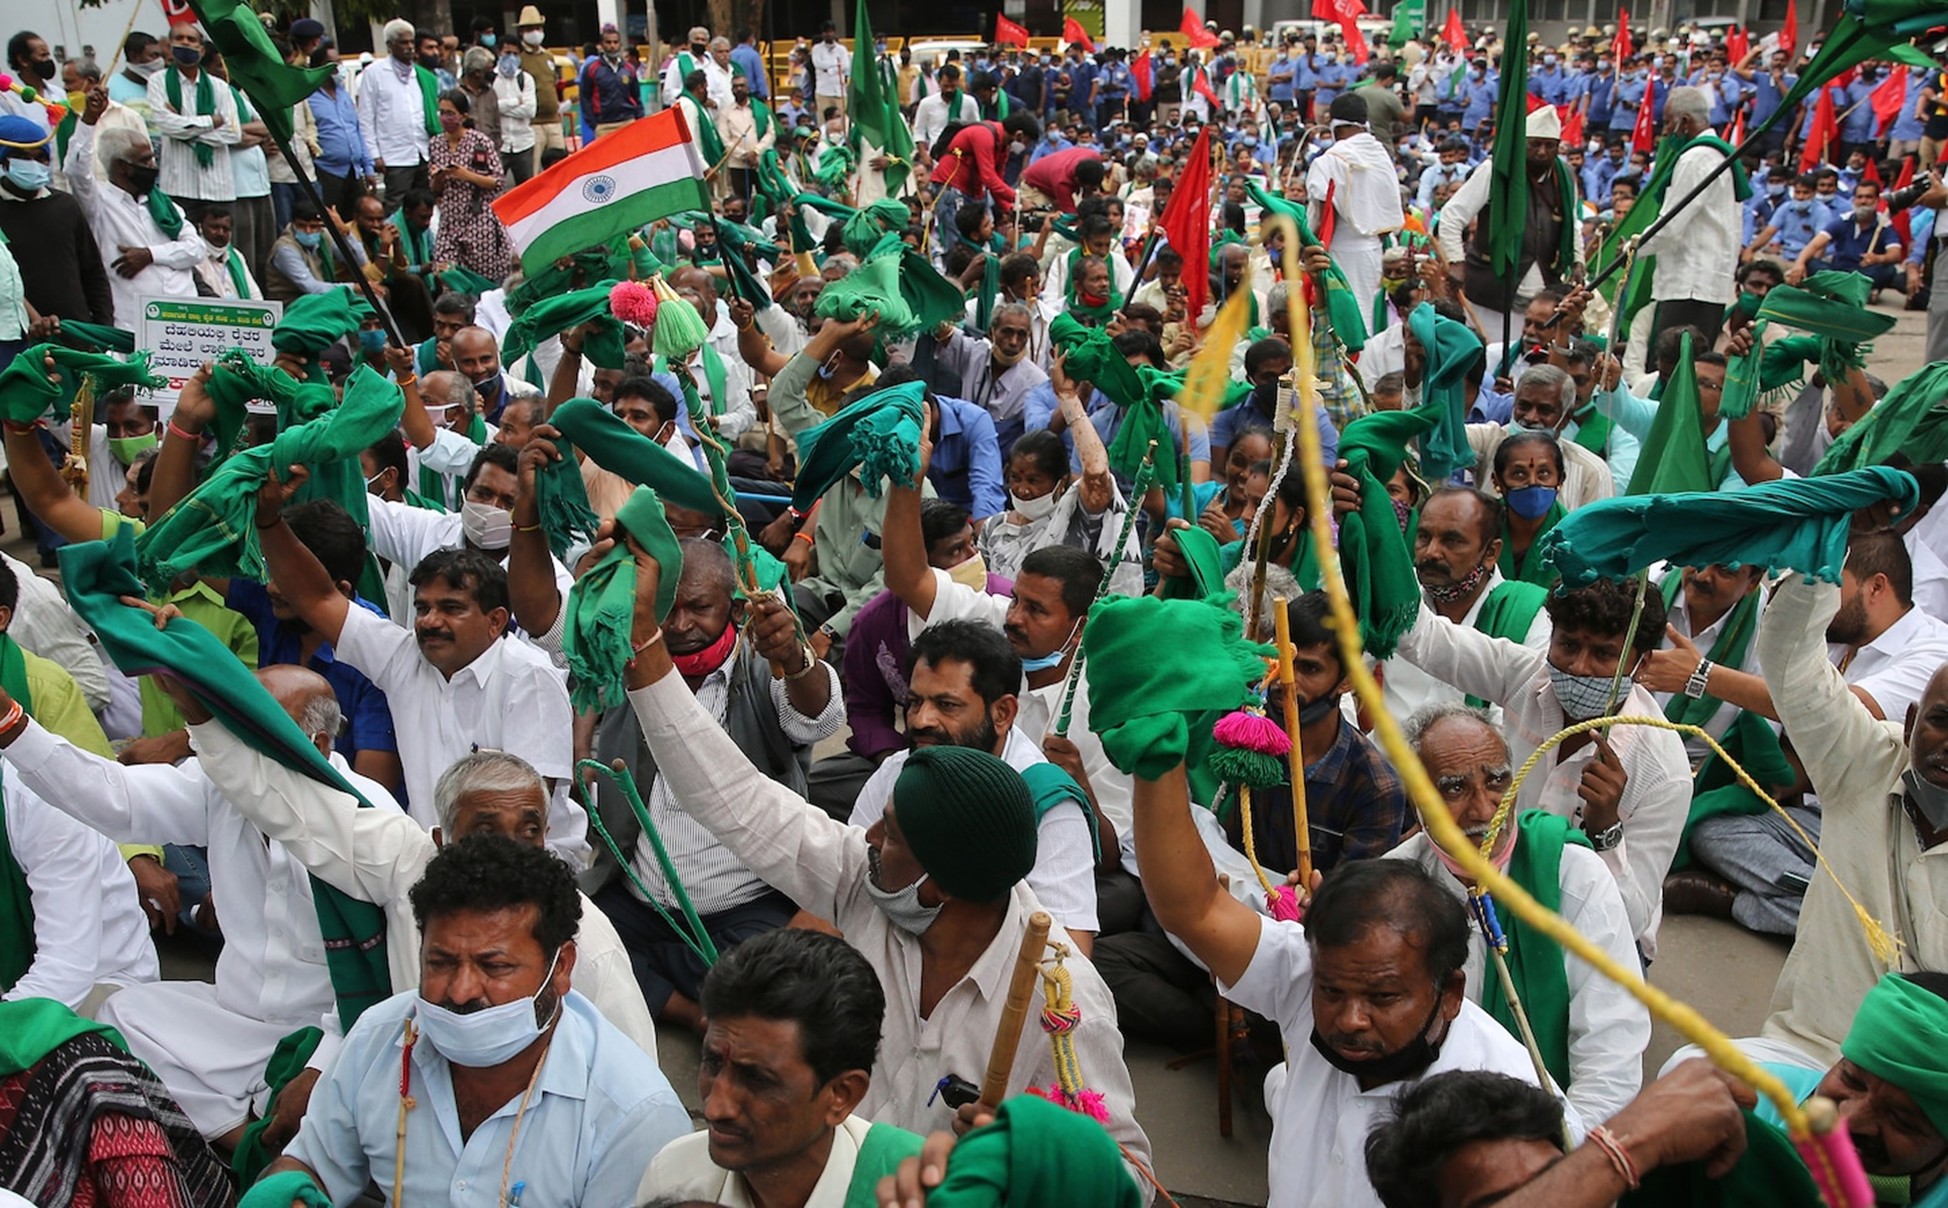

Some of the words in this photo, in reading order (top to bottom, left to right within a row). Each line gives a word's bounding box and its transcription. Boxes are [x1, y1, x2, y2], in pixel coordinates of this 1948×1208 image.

[165, 324, 226, 342] ದೆಹಲಿಯಲ್ಲಿ
[232, 328, 260, 345] ರೈತರ
[160, 339, 193, 353] ಮೇಲೆ
